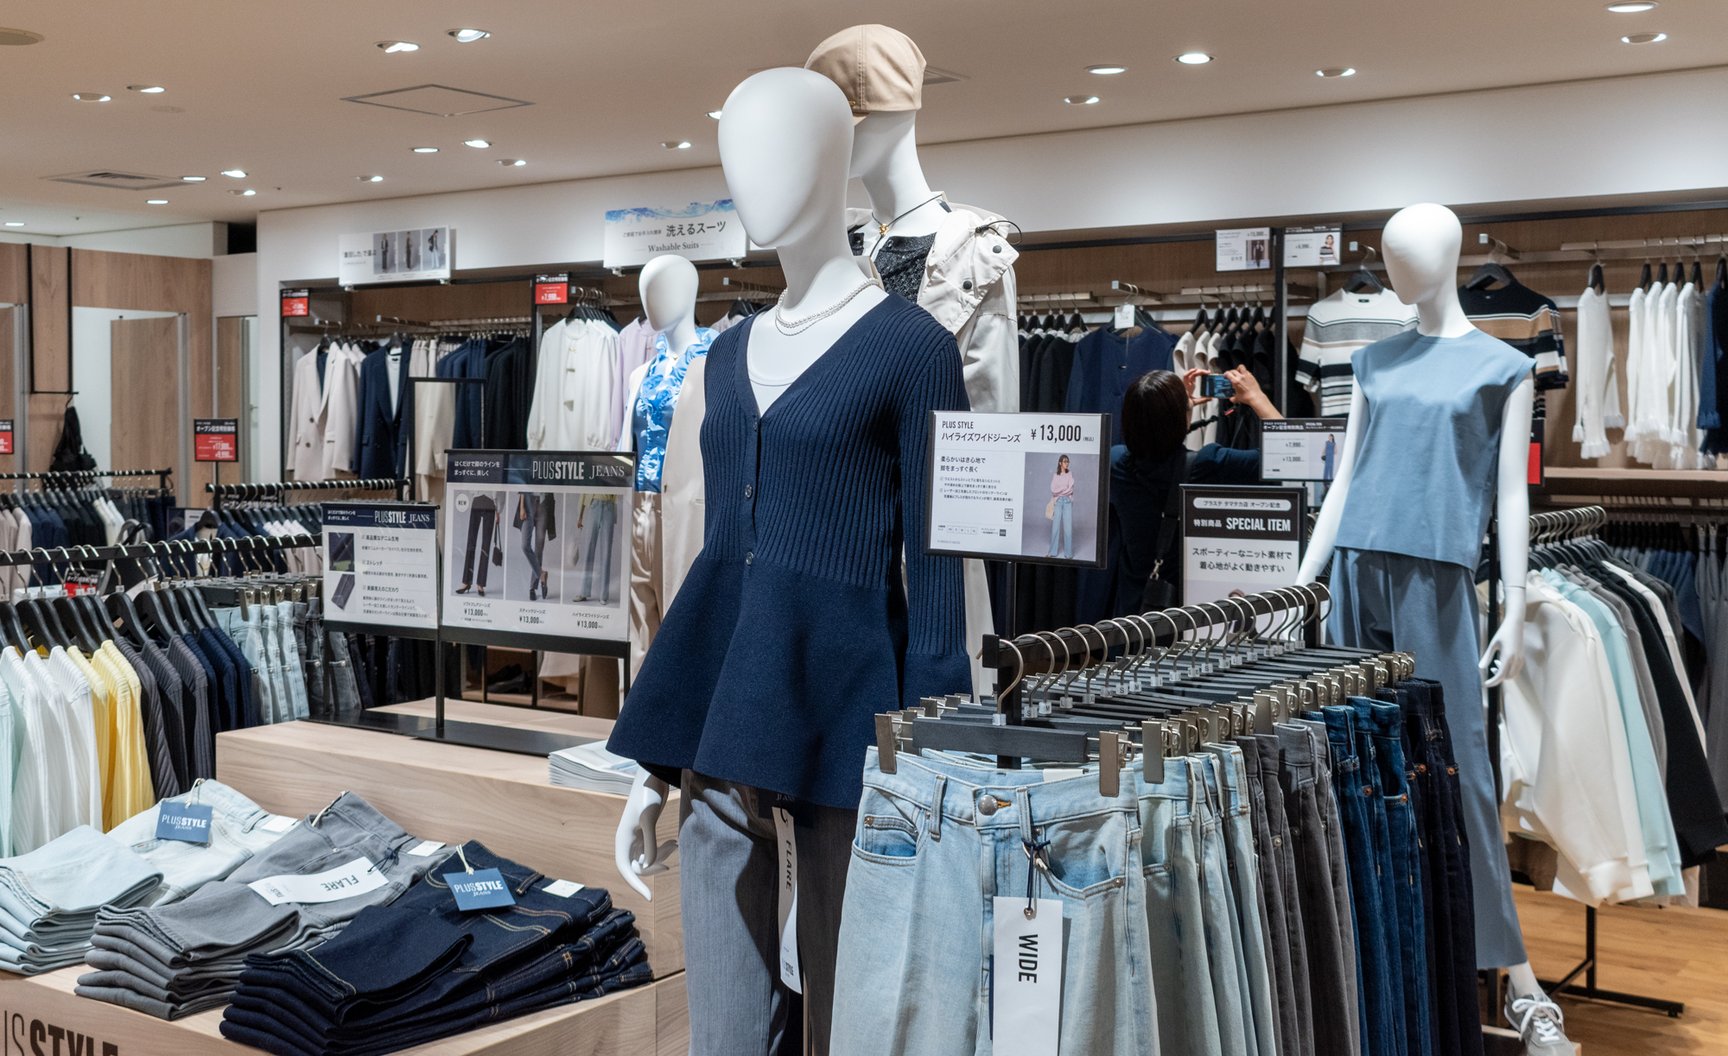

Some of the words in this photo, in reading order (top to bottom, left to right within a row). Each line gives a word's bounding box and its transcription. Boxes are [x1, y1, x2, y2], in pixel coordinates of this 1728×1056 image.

[666, 221, 726, 237] 洗えるスーツ
[648, 243, 681, 252] Washable
[682, 241, 699, 250] Suits
[942, 420, 956, 429] PLUS
[957, 421, 974, 430] STYLE
[941, 432, 1021, 443] ハイライズワイドジーンズ
[941, 456, 986, 464] 柔らかいはき心地で
[589, 465, 625, 479] JEANS
[408, 514, 430, 524] JEANS
[1193, 519, 1222, 528] 特別商品
[1226, 517, 1265, 531] SPECIAL
[1267, 519, 1291, 532] ITEM
[1192, 547, 1292, 560] スポーティーなニット素材で
[1200, 561, 1285, 573] 着心地がよく動きやすい
[785, 839, 793, 892] FLARE
[321, 875, 359, 891] FLARE
[1018, 934, 1038, 984] WIDE
